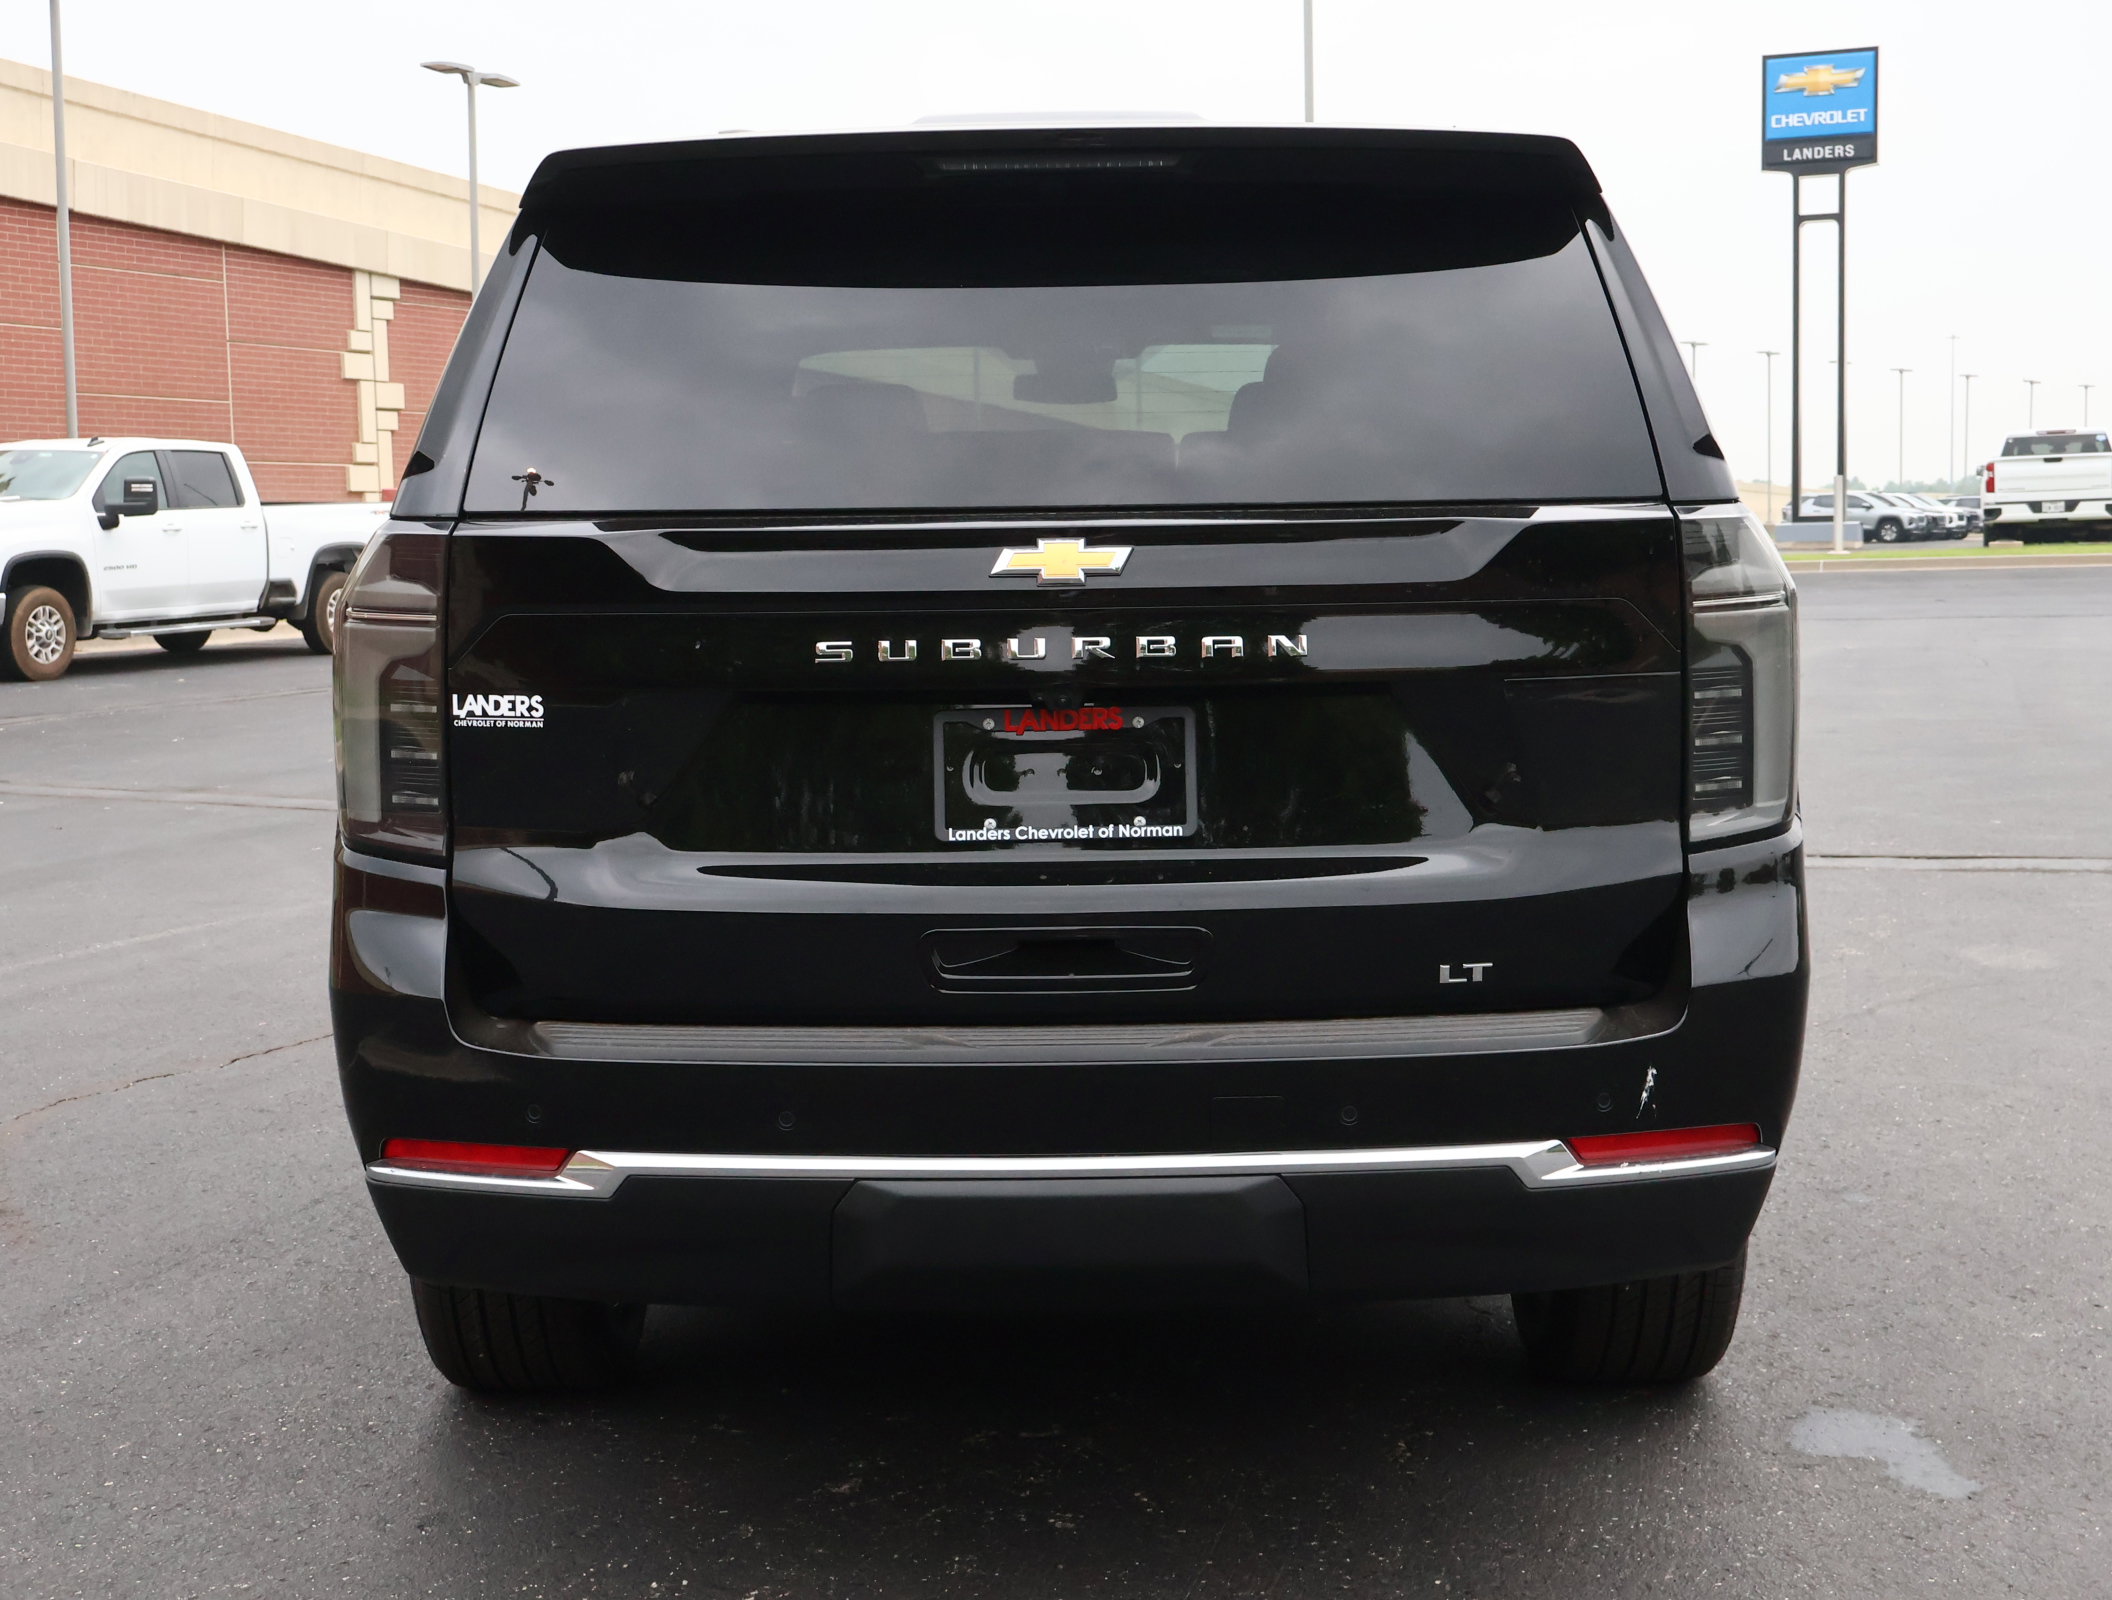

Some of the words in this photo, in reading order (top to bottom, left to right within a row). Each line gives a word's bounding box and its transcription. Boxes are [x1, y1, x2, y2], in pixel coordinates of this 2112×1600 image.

[1770, 108, 1868, 128] CHEVROLET
[1783, 144, 1855, 160] LANDERS
[815, 634, 1309, 663] SUBURBAN
[452, 693, 545, 718] LANDERS
[453, 720, 494, 728] CHEVROLET
[507, 720, 544, 728] NORMAN
[1004, 707, 1124, 735] LANDERS
[948, 827, 1010, 841] Landers
[1015, 825, 1094, 840] Chevrolet
[1098, 824, 1114, 838] of
[1118, 824, 1183, 838] Norman
[1440, 962, 1493, 983] LT
